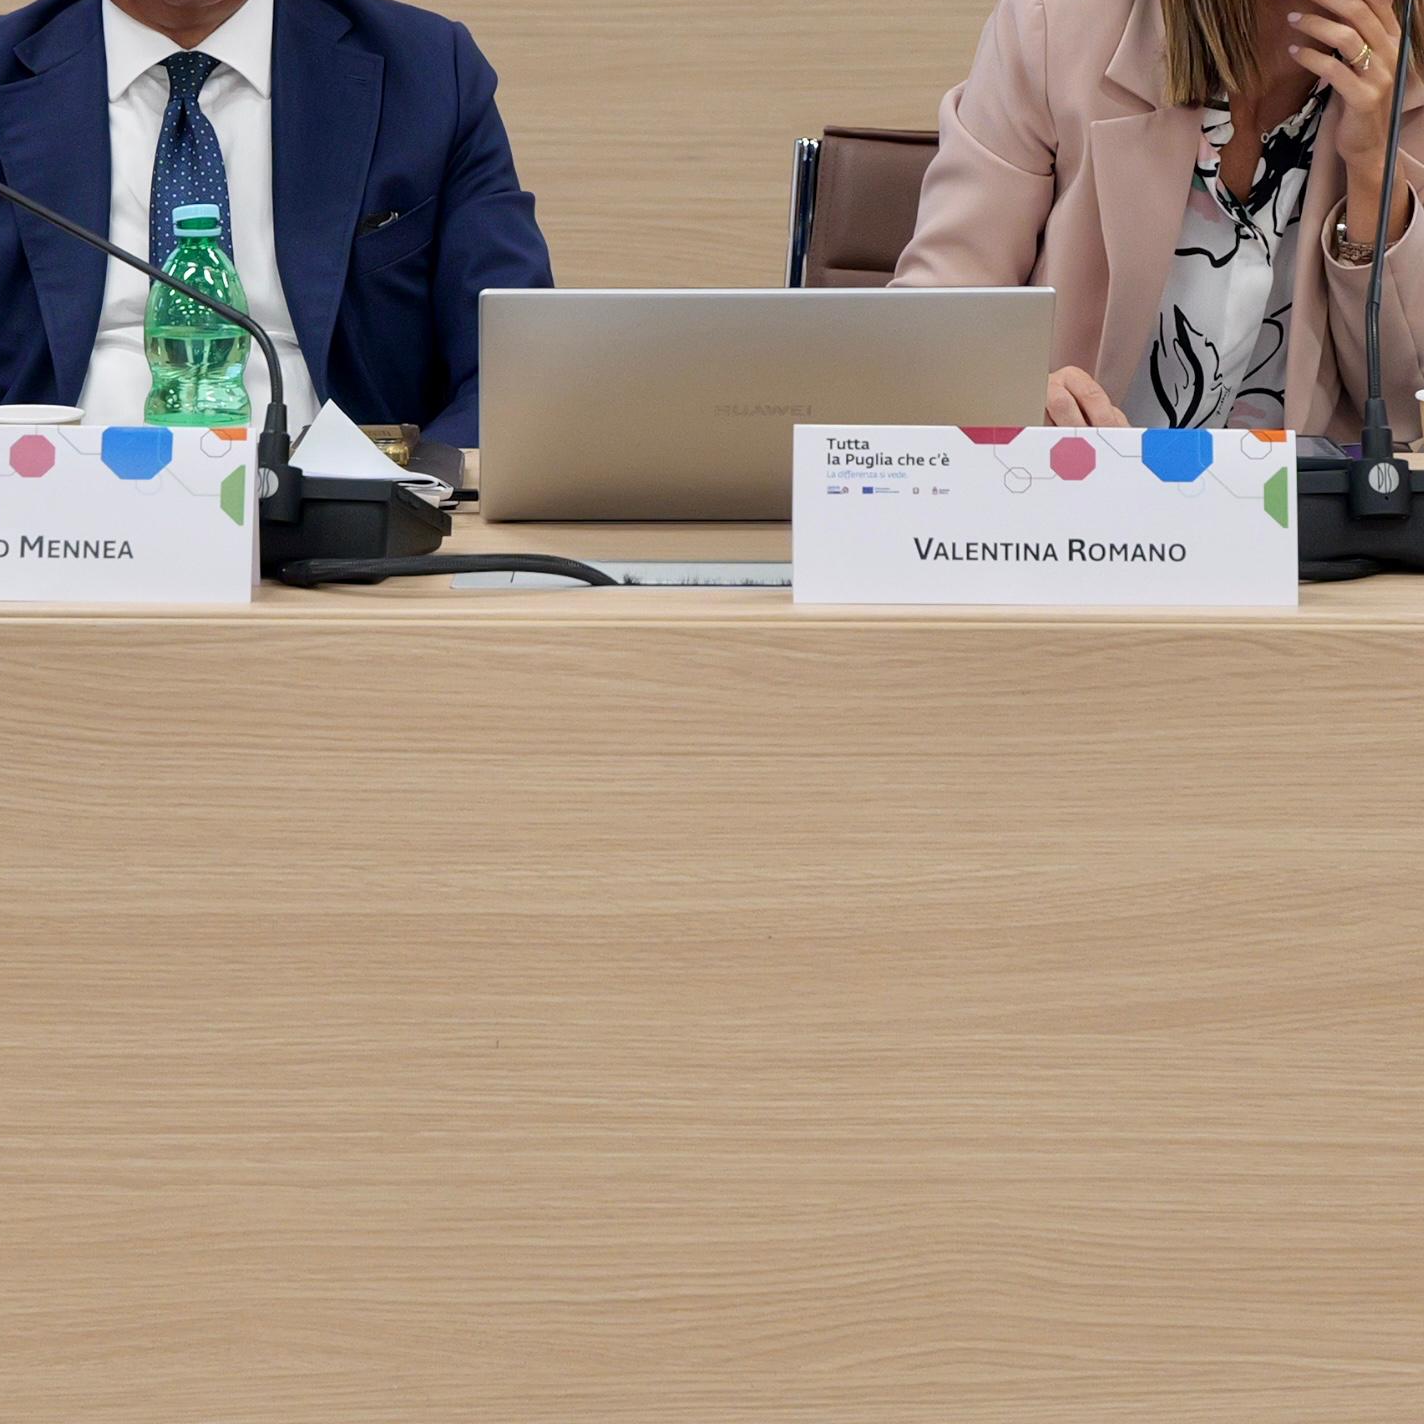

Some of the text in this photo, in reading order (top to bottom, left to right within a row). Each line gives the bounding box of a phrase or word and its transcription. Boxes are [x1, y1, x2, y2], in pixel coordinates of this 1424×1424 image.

[714, 405, 812, 416] HUAWEI
[826, 438, 870, 450] Tutta
[827, 453, 840, 465] la
[845, 452, 893, 469] Puglia
[897, 453, 925, 466] che
[19, 534, 134, 560] MENNEA
[913, 537, 1187, 563] VALENTINA ROMANO
